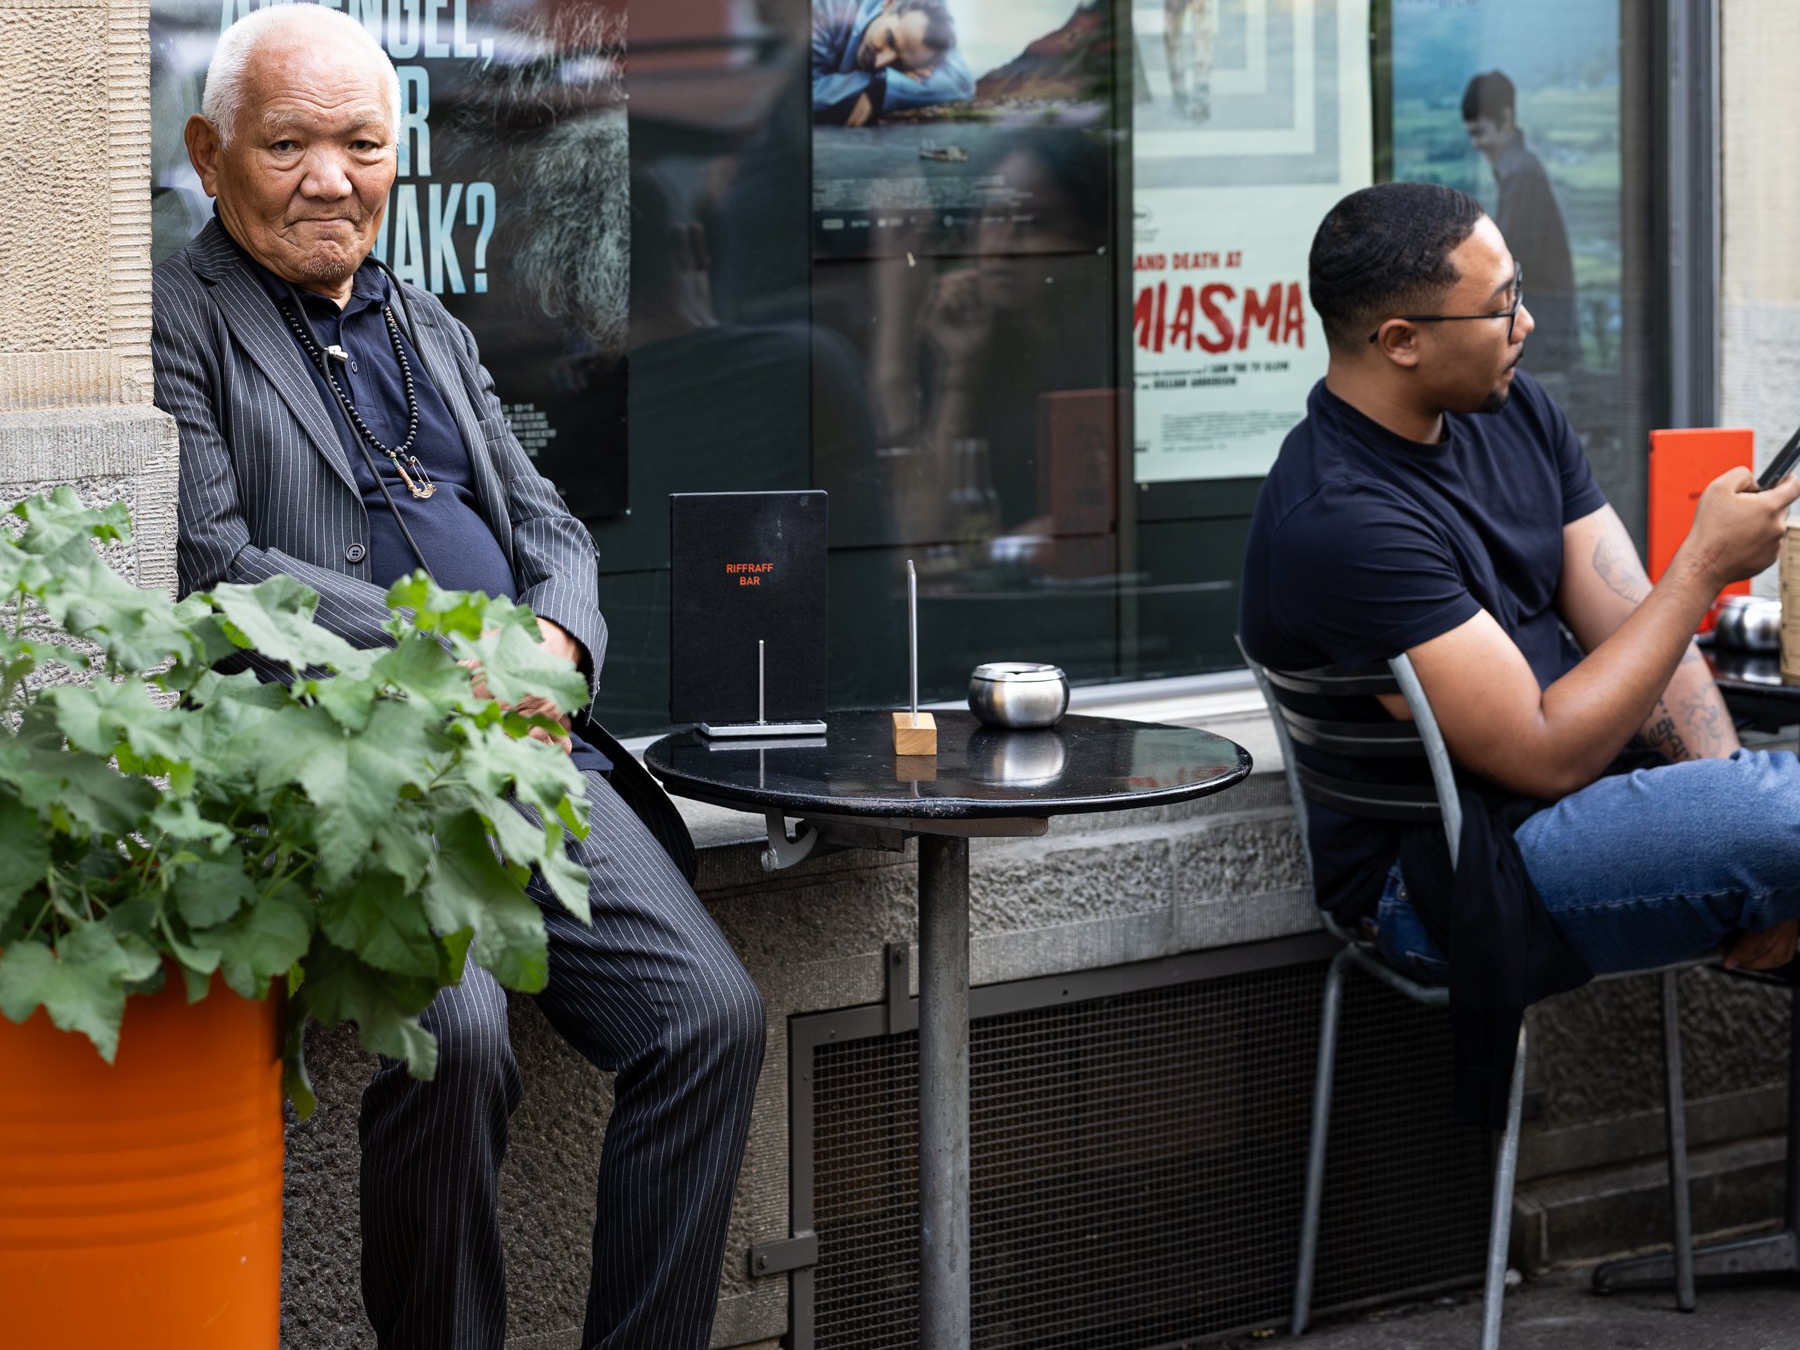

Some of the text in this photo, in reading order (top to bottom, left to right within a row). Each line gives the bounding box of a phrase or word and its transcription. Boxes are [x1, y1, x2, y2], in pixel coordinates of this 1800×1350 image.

[1134, 250, 1242, 271] AND DEATH AT
[1134, 280, 1305, 355] MIASMA
[726, 563, 774, 574] RIFFRAFF
[739, 576, 760, 586] BAR
